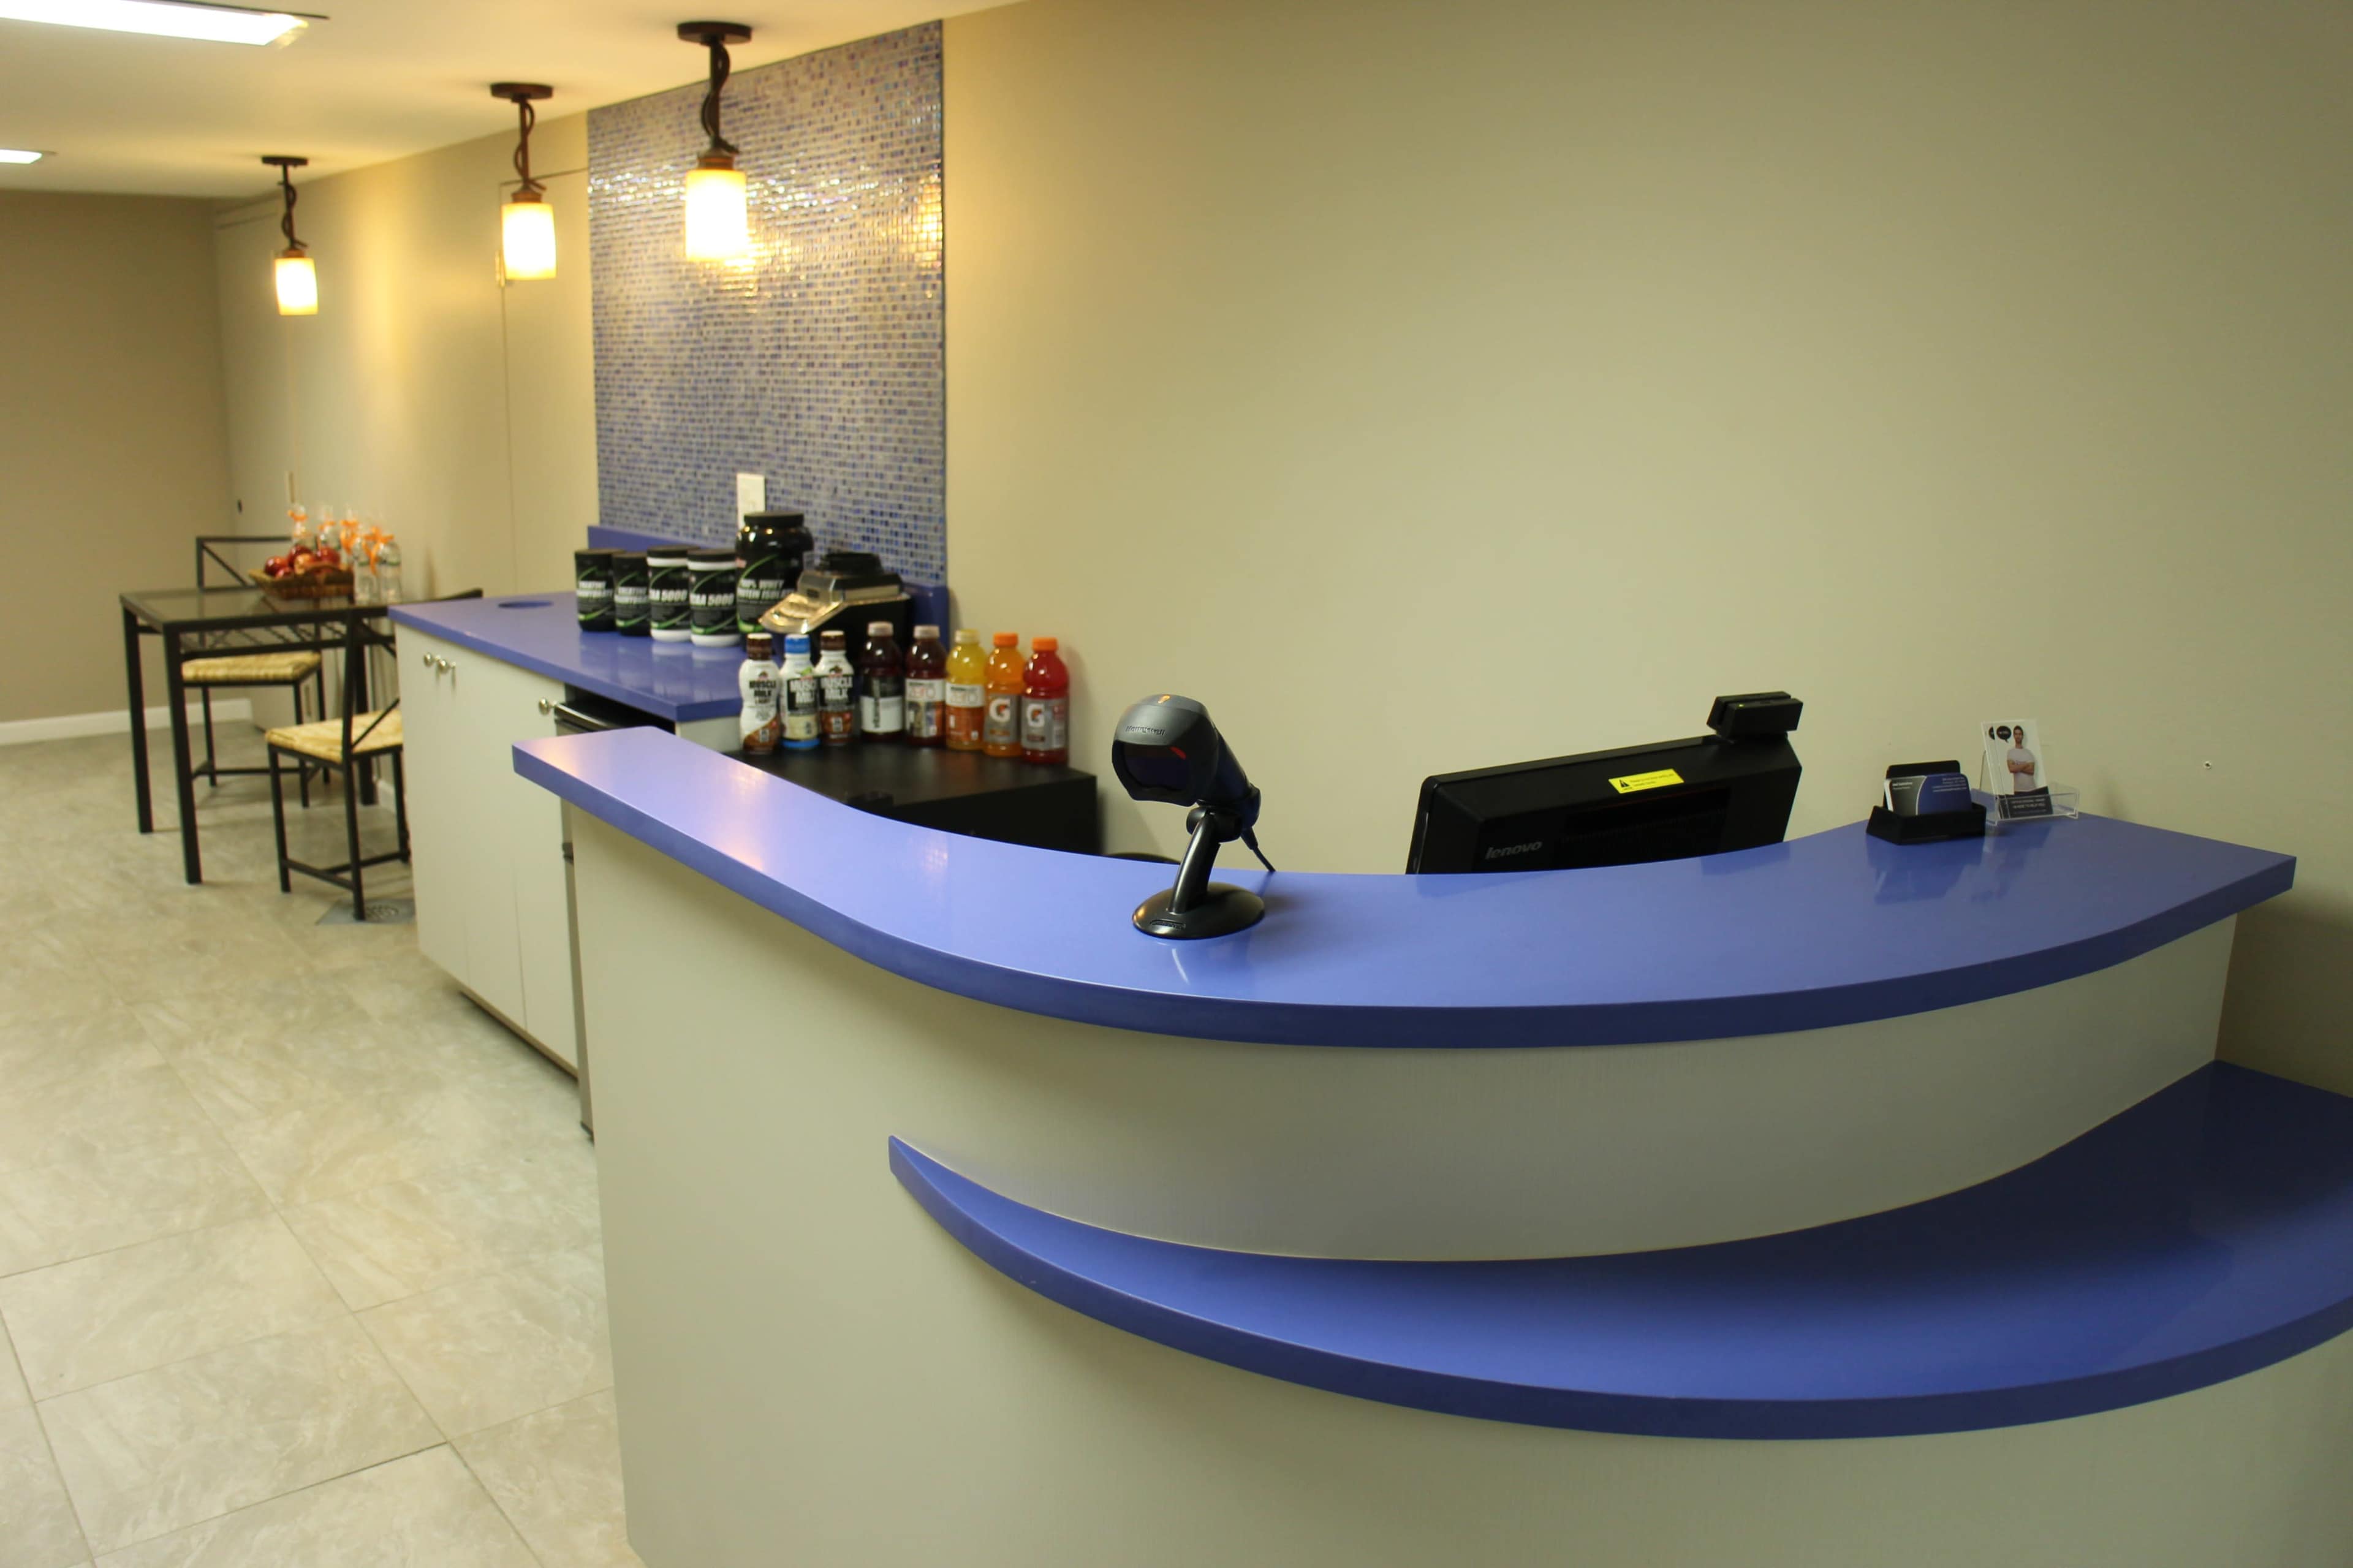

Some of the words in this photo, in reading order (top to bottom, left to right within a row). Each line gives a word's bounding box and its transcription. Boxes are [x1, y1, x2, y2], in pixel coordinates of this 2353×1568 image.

[989, 698, 1010, 723] G
[1026, 703, 1045, 727] G
[1125, 725, 1165, 736] Honeywell
[1485, 842, 1543, 860] lenovo
